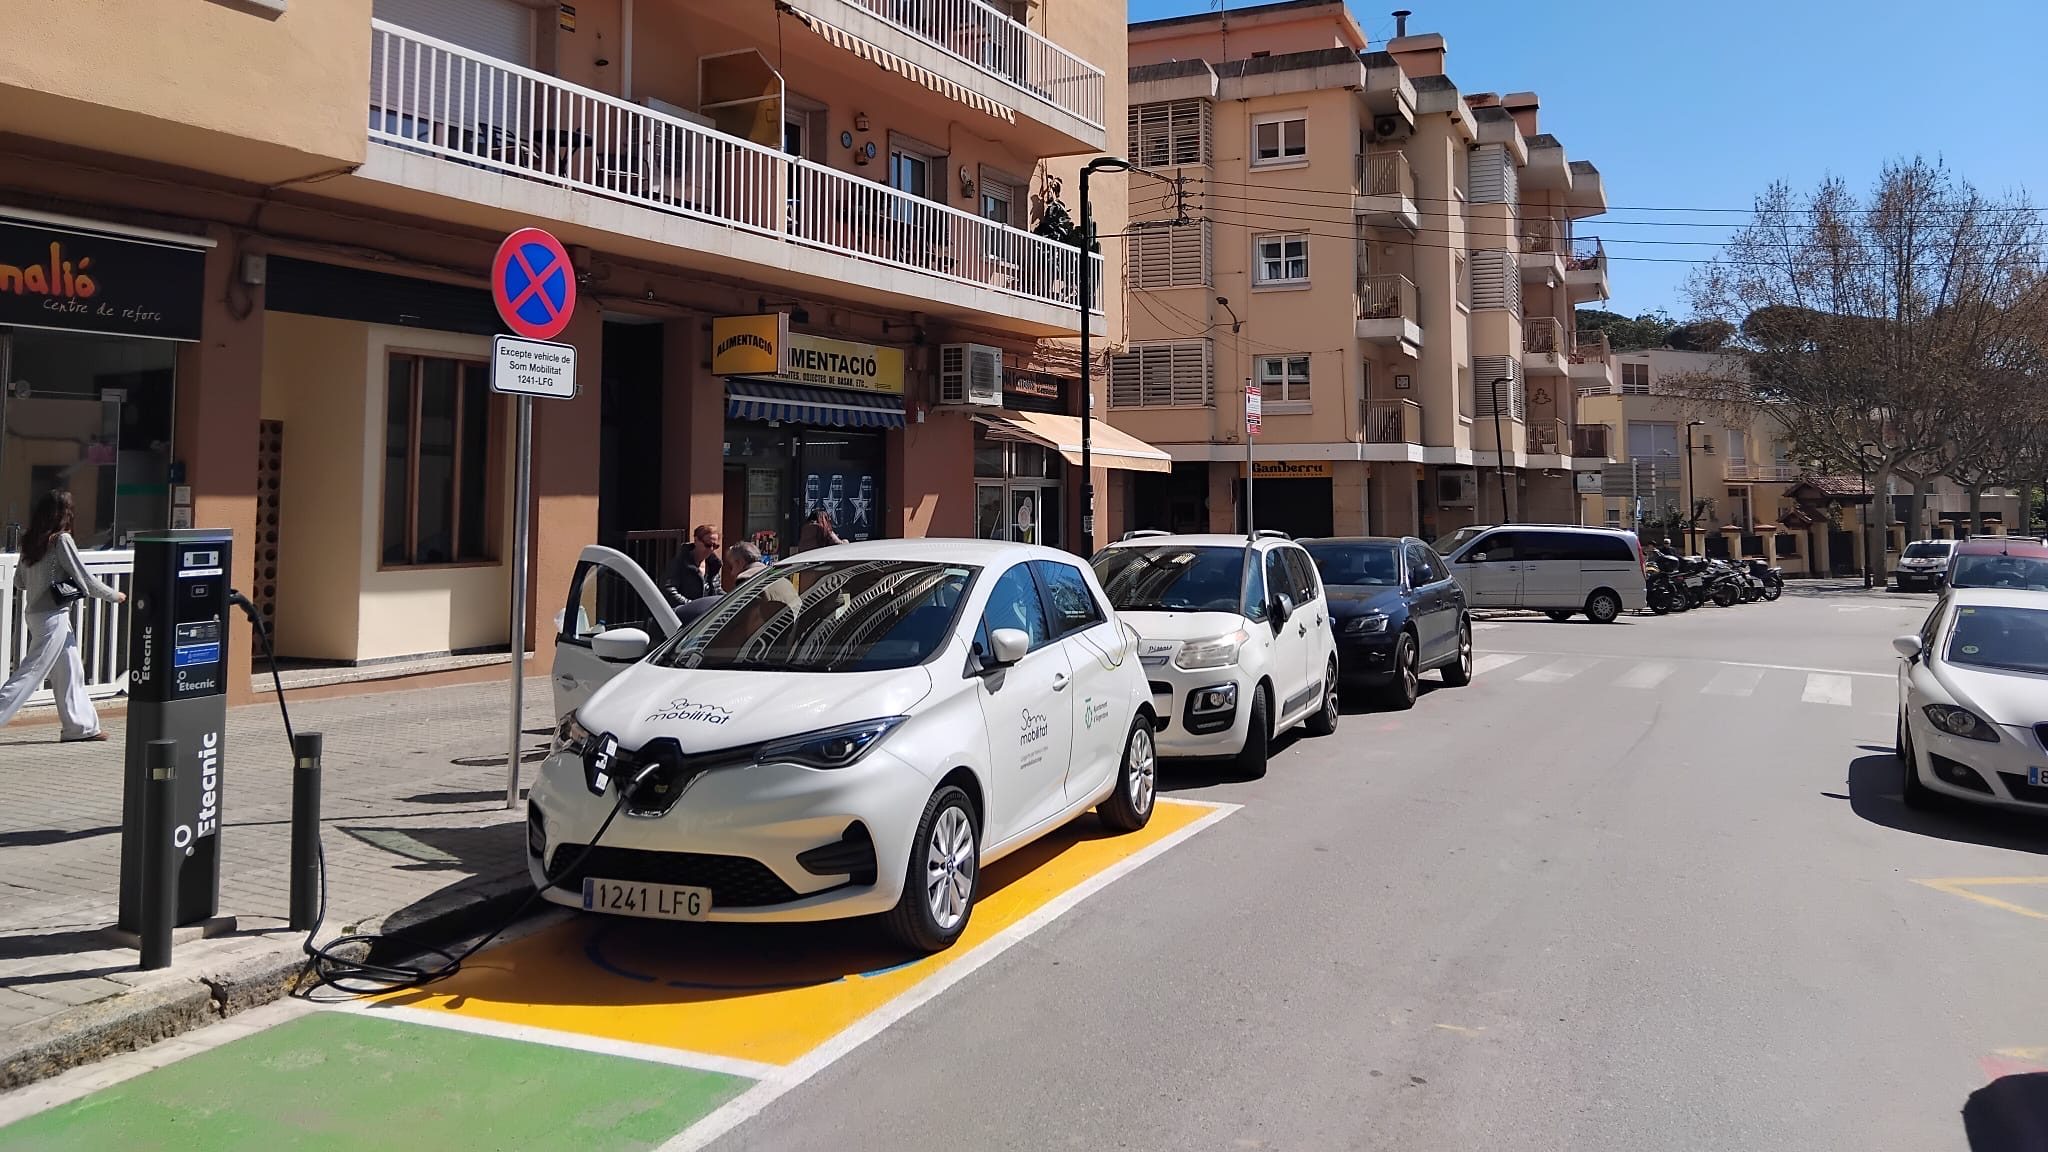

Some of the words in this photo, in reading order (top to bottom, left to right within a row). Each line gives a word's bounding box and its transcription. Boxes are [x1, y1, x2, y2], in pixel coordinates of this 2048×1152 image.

[43, 298, 89, 314] centre
[96, 302, 114, 317] de
[500, 347, 532, 359] Excepte
[534, 352, 559, 362] vehicle
[561, 355, 571, 364] de
[716, 334, 773, 358] ALIMENTACIÓ
[509, 360, 527, 371] Som
[529, 363, 561, 375] Mobilitat
[788, 347, 877, 377] IMENTACIÓ
[518, 375, 553, 386] 1241-LFG
[829, 376, 836, 384] DE
[142, 626, 152, 681] Etecnic
[179, 679, 215, 691] Etecnic
[645, 710, 731, 726] mobilitat
[1020, 723, 1048, 746] mobilitat
[198, 732, 217, 838] Etecnic
[599, 883, 647, 911] 1241
[658, 889, 701, 916] LFG
